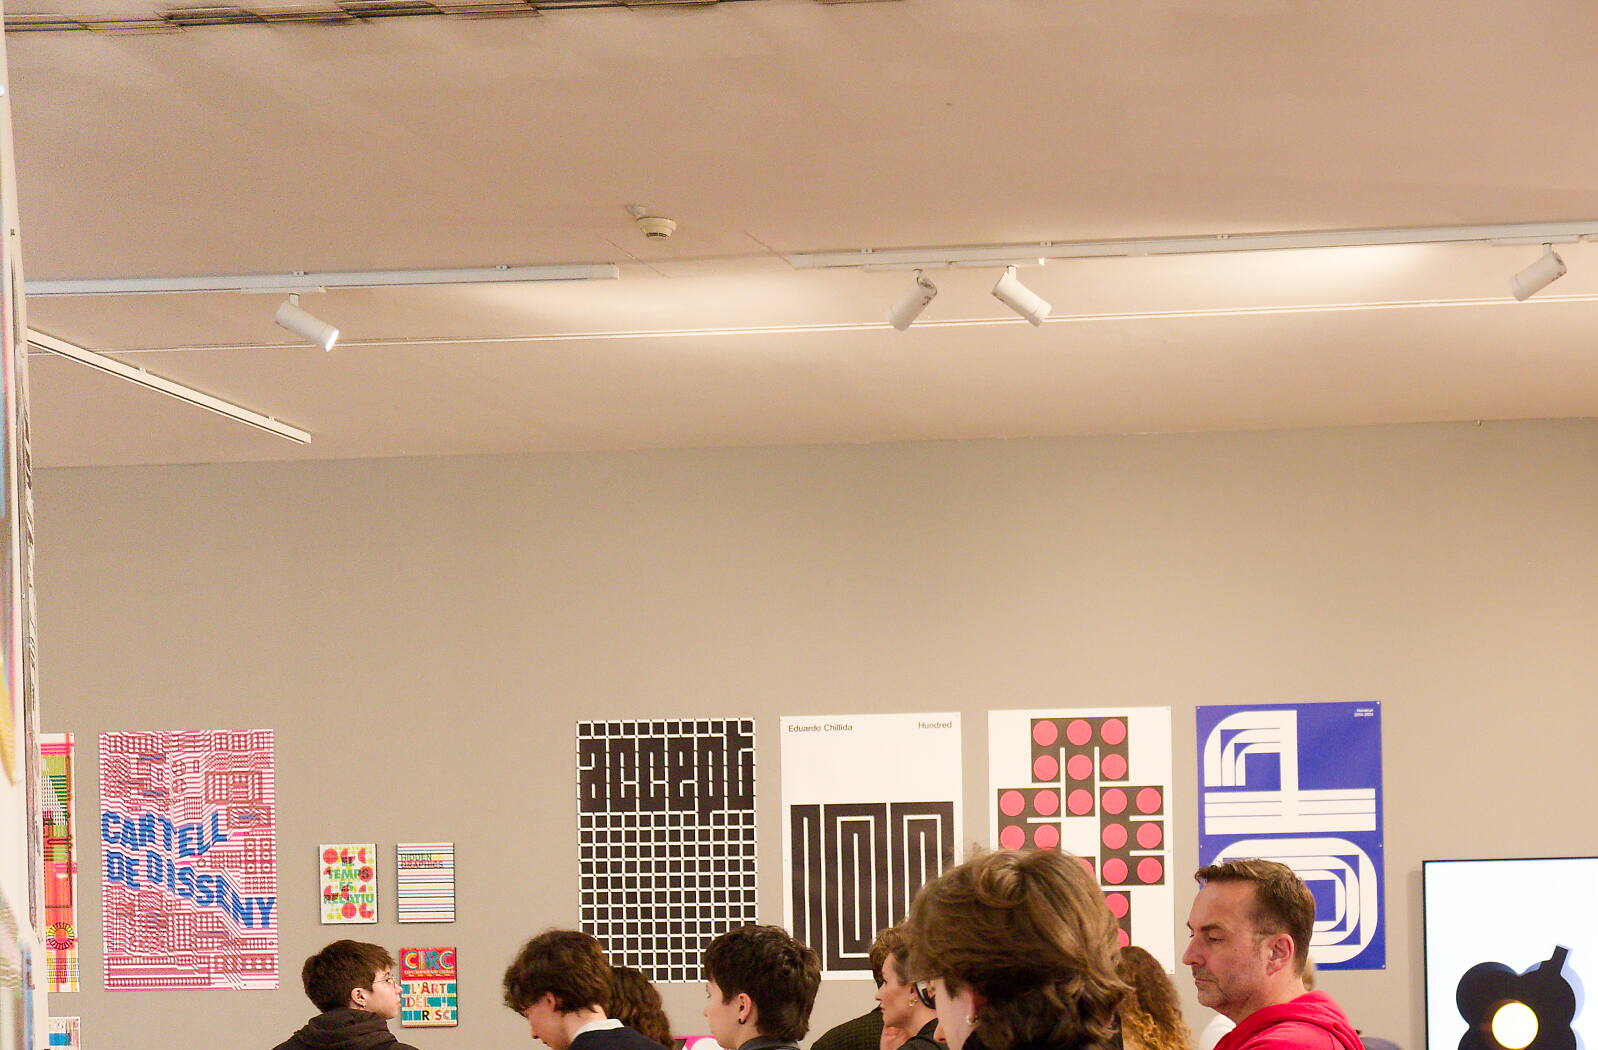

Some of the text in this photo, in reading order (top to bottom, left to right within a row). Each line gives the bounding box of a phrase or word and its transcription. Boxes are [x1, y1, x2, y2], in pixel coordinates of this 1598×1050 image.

[788, 723, 853, 732] Eduardo Chillida
[918, 721, 952, 729] Hundred
[578, 722, 755, 827] accept
[400, 853, 432, 861] HIDDEN
[106, 850, 141, 890] DE
[328, 868, 369, 879] TEMPS
[403, 950, 454, 970] CIRC
[411, 982, 446, 994] L'ART
